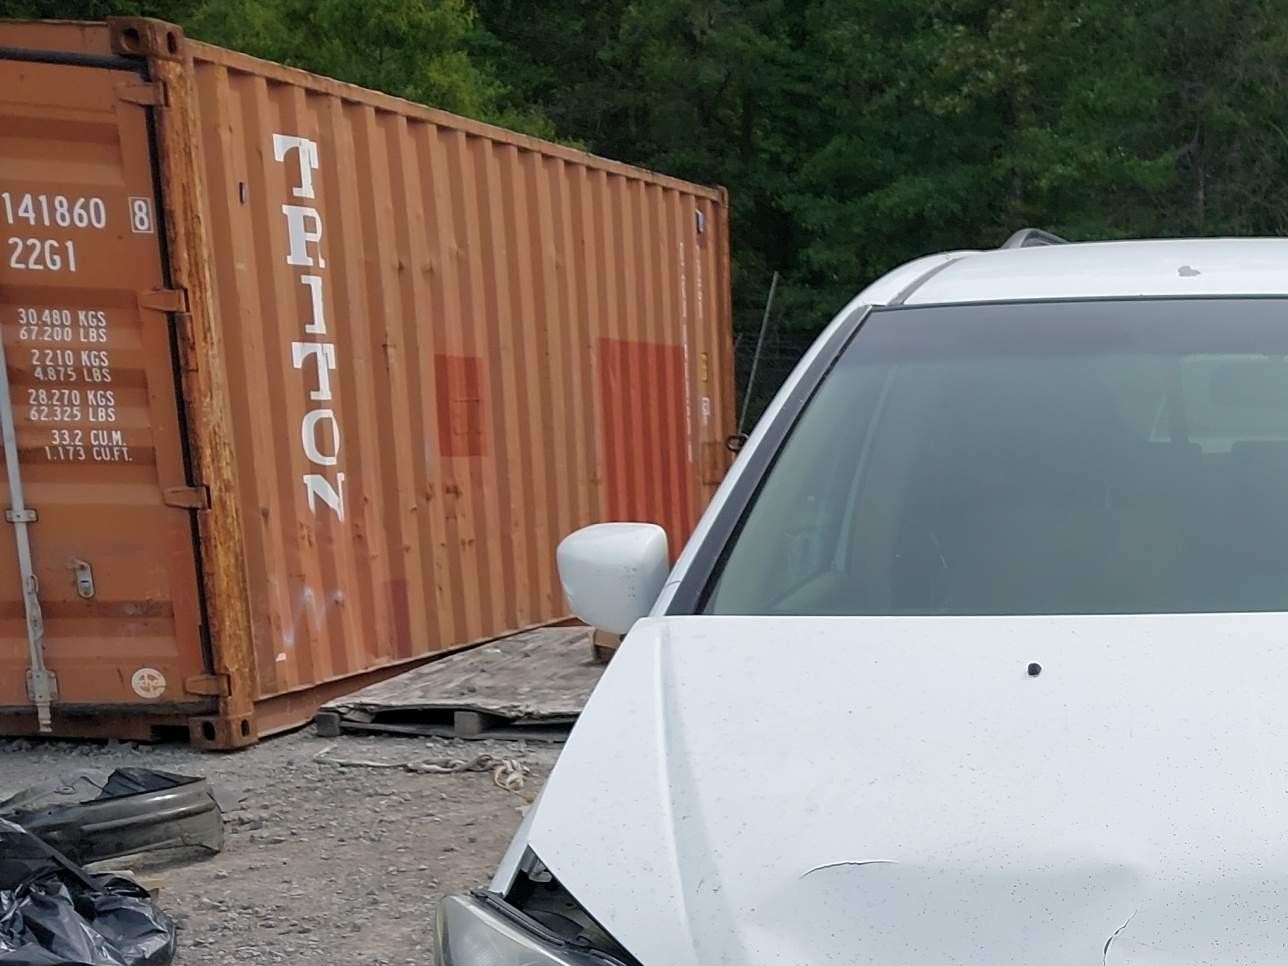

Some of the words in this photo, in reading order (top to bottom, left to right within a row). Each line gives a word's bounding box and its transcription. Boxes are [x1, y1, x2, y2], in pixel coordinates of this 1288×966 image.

[1, 192, 106, 229] 141860
[133, 200, 149, 230] 8
[8, 237, 76, 272] 22G1
[17, 308, 72, 326] 30.480
[78, 310, 107, 327] KGS
[19, 326, 73, 342] 67.200
[80, 328, 108, 343] LBS
[272, 133, 345, 523] TRITON
[81, 350, 109, 367] KGS
[34, 366, 77, 382] 4.875
[83, 368, 112, 383] LBS
[28, 388, 80, 405] 28.270
[87, 390, 115, 406] KGS
[30, 406, 81, 421] 62.325
[89, 407, 116, 422] LBS
[51, 429, 83, 446] 33.2
[90, 430, 127, 446] CU.M.
[44, 446, 86, 461] 1.173
[92, 447, 133, 462] CU.FT.
